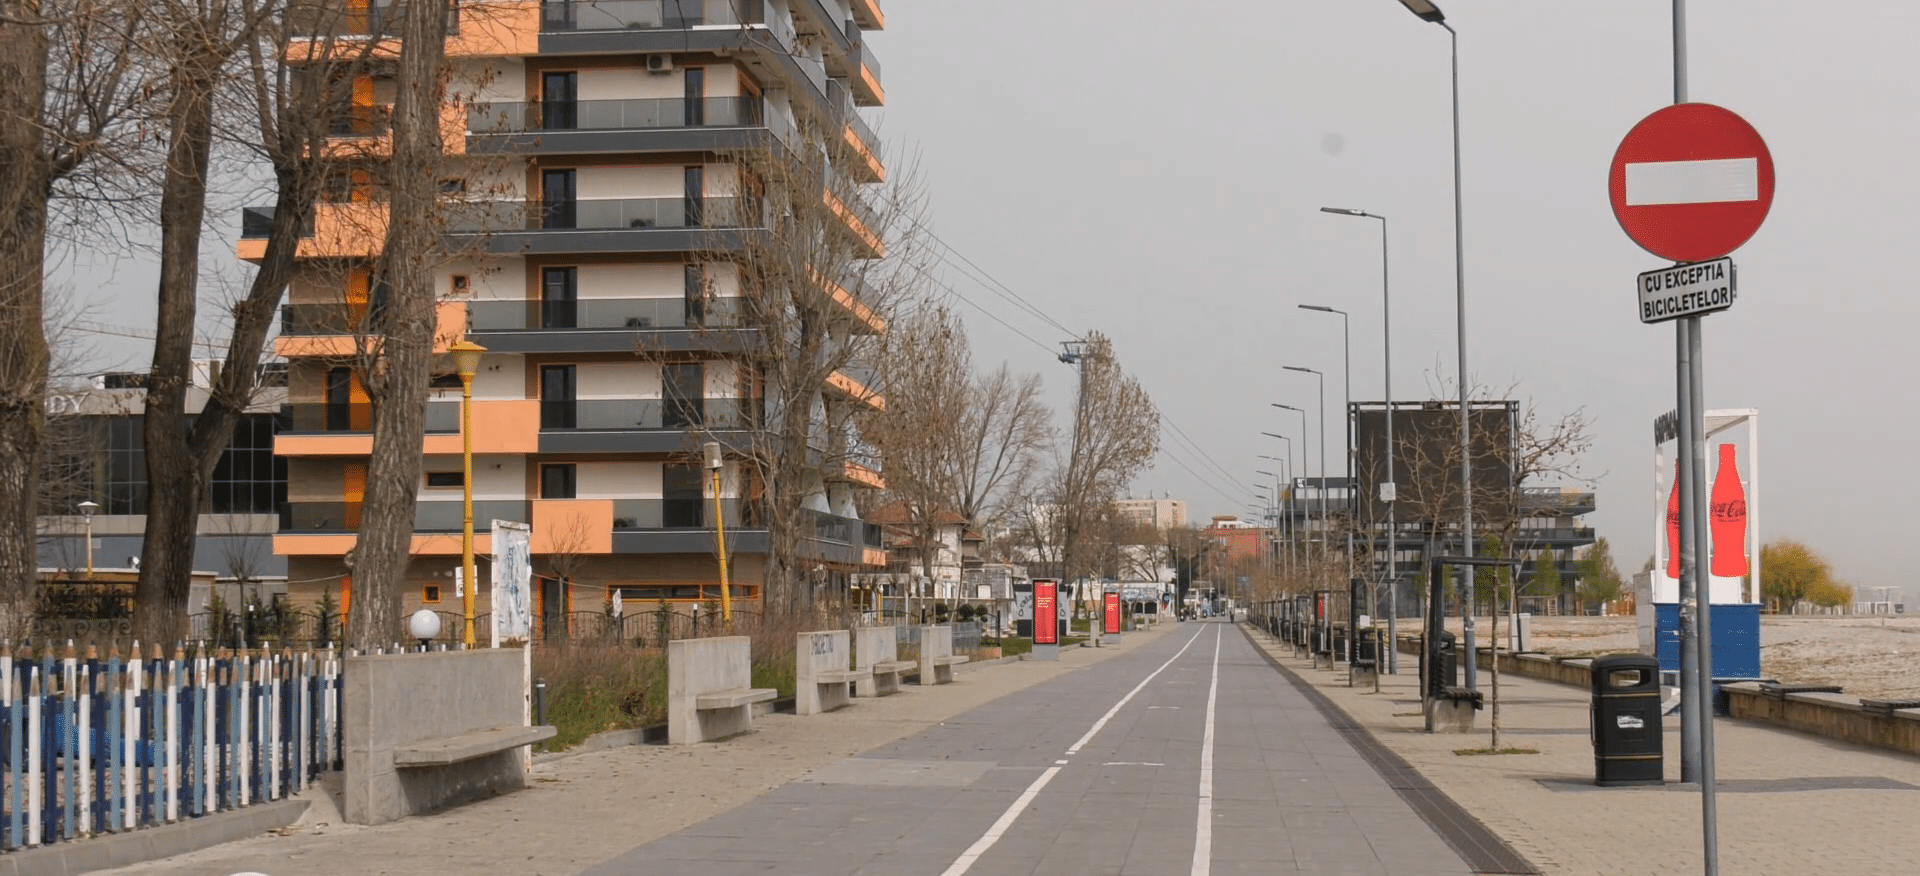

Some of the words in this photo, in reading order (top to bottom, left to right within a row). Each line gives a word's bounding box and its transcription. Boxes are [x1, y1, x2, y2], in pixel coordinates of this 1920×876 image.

[1645, 274, 1661, 293] CU
[1665, 263, 1724, 289] EXCEPTIA
[1643, 287, 1729, 318] BICICLETELOR
